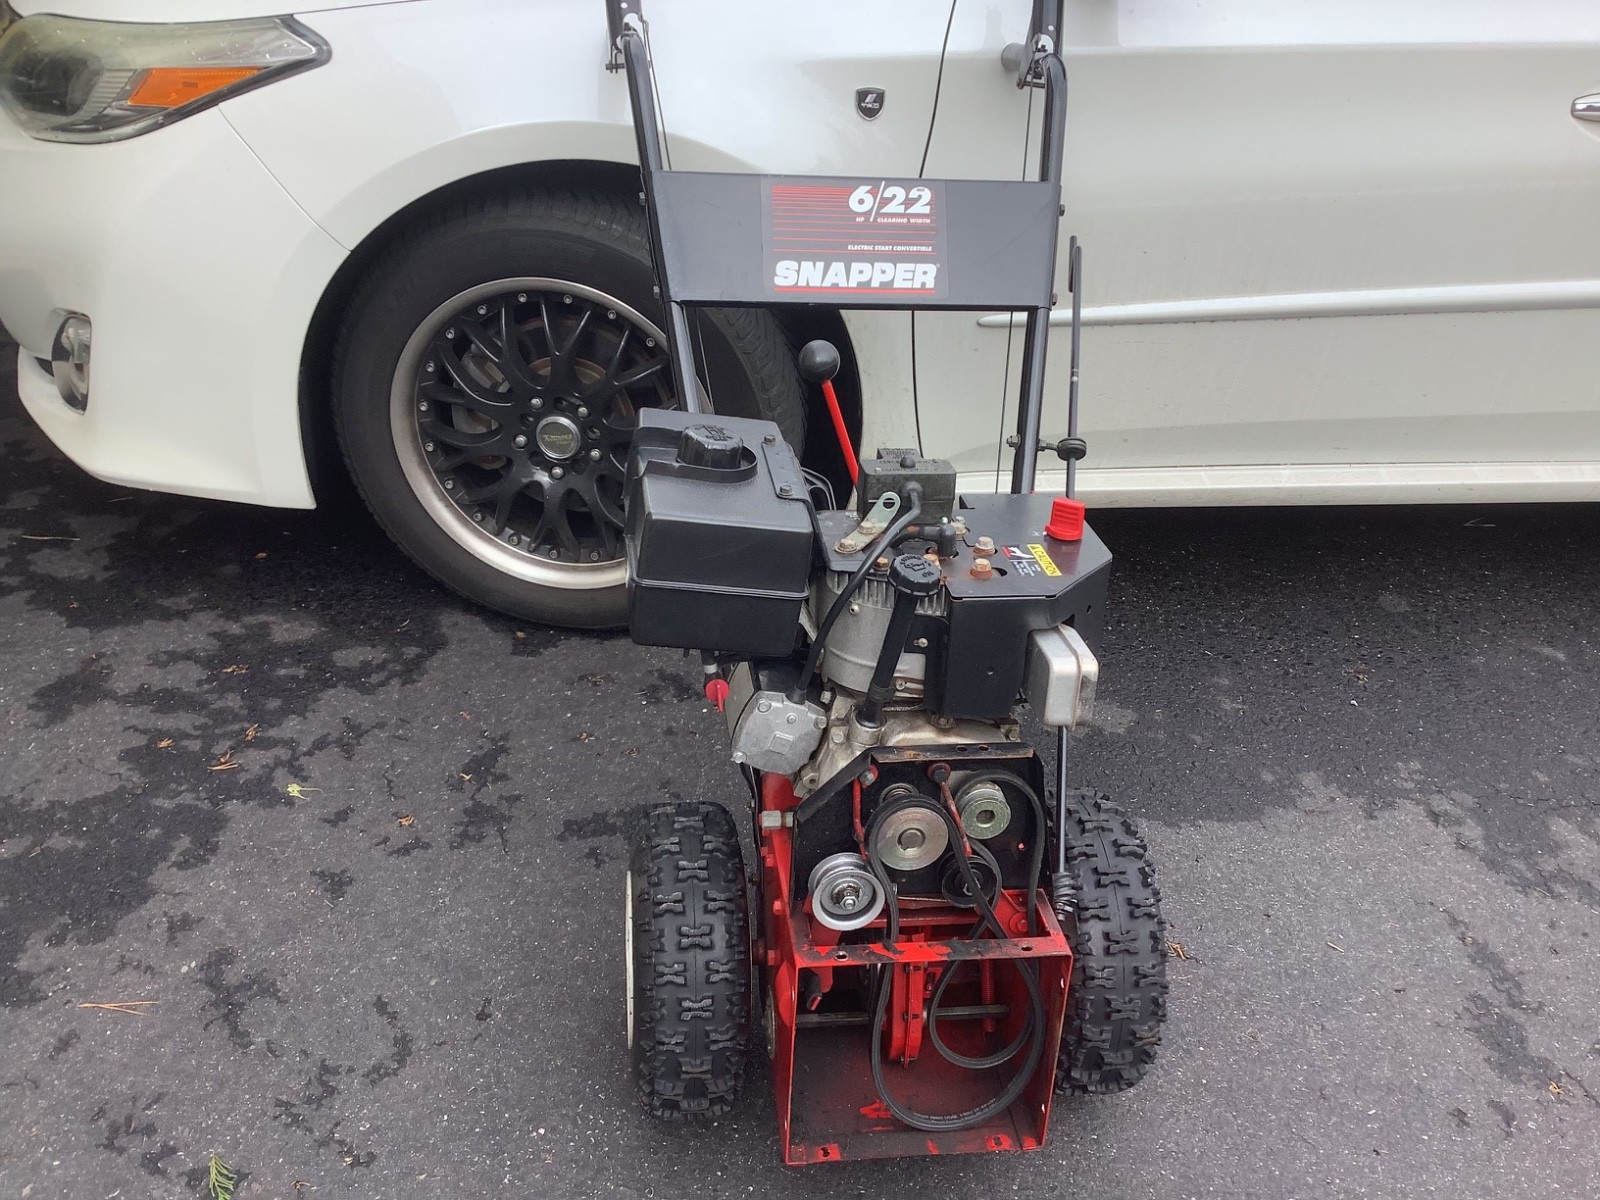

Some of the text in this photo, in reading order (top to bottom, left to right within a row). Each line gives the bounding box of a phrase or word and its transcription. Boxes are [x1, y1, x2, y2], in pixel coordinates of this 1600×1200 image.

[848, 181, 932, 222] 6/22
[774, 259, 937, 289] SNAPPER
[1033, 550, 1058, 575] CAUTION
